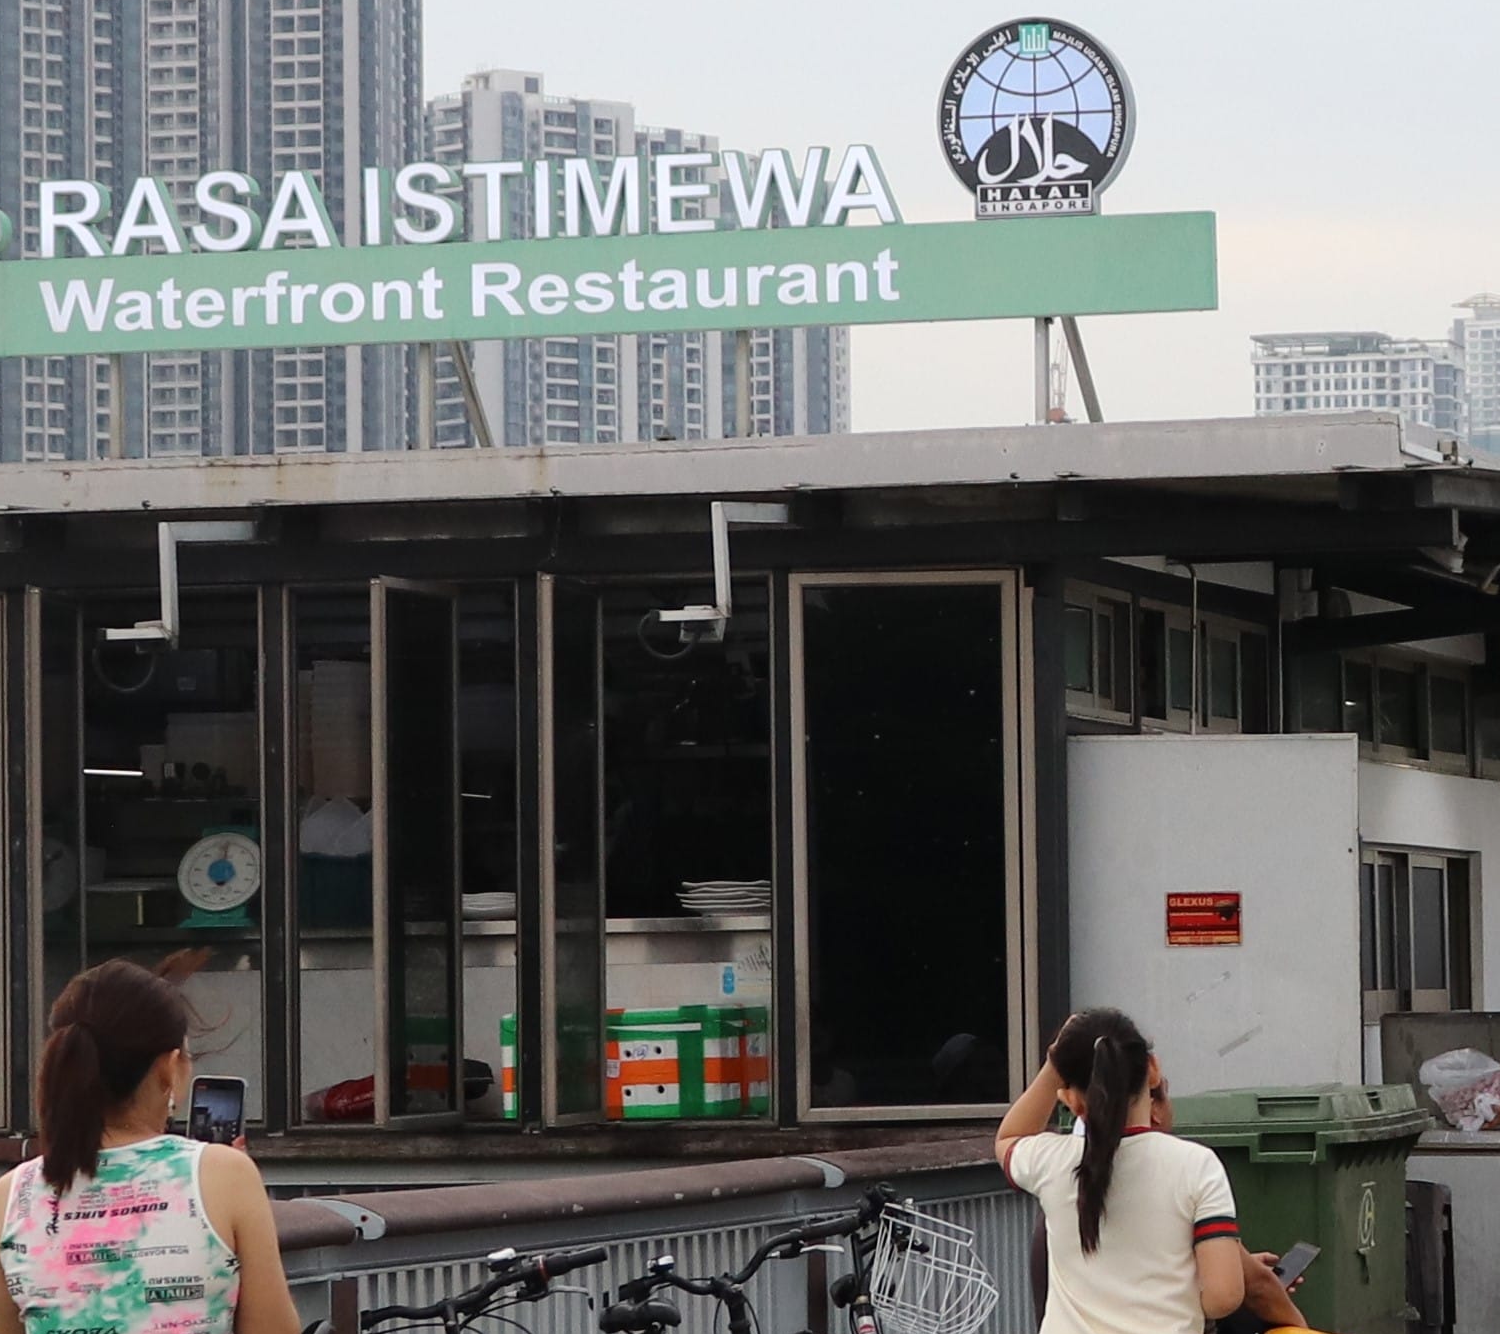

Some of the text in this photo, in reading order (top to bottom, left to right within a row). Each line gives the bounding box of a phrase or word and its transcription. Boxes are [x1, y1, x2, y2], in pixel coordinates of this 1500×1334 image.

[1052, 30, 1084, 51] MAJLIS
[1106, 73, 1122, 104] ISLAM
[39, 144, 901, 258] RASA ISTIMEWA
[987, 184, 1082, 201] HALAL
[980, 200, 1091, 214] SINGAPORE
[38, 246, 901, 334] Waterfront Restaurant
[1168, 897, 1214, 907] GLEXUS
[63, 1201, 169, 1221] BUENOS AIRES
